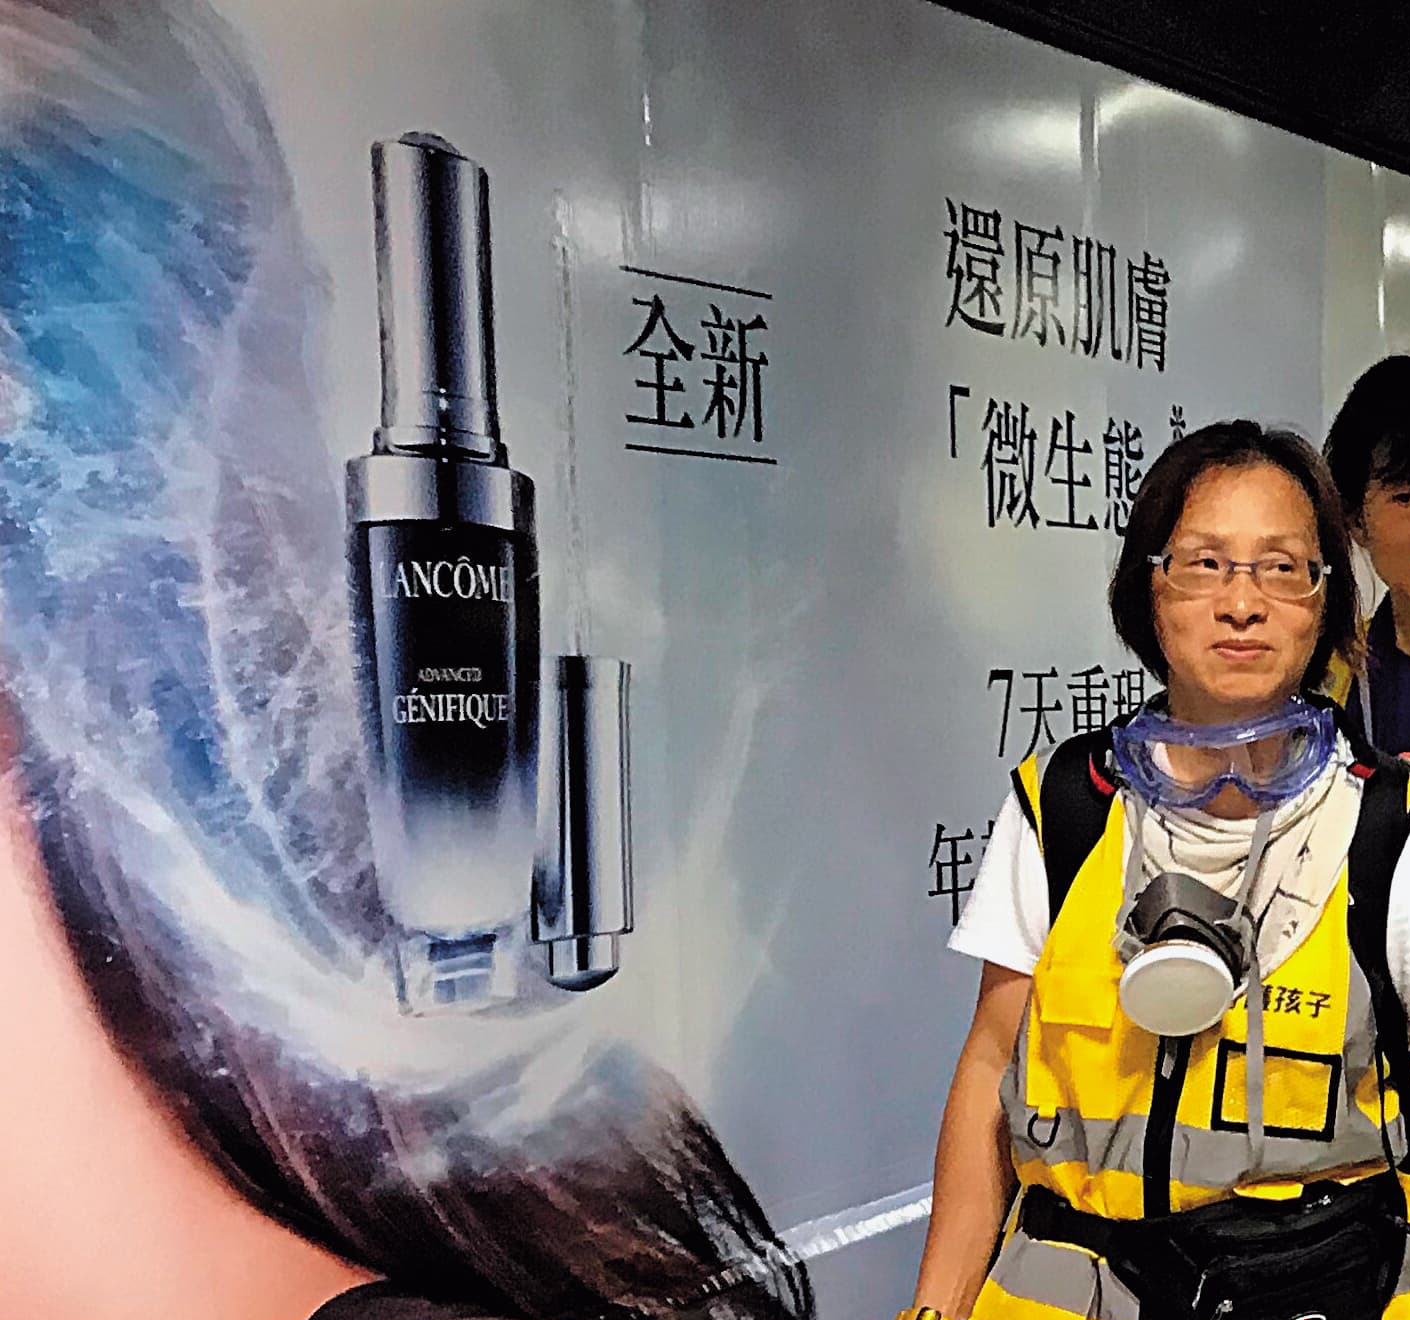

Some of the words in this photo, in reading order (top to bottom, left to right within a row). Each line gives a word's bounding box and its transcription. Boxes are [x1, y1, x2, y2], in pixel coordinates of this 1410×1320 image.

[944, 197, 1171, 372] 還原肌膚
[624, 294, 770, 444] 全新
[391, 687, 510, 729] GÉNIFIQUE
[418, 667, 483, 682] ADVANCED
